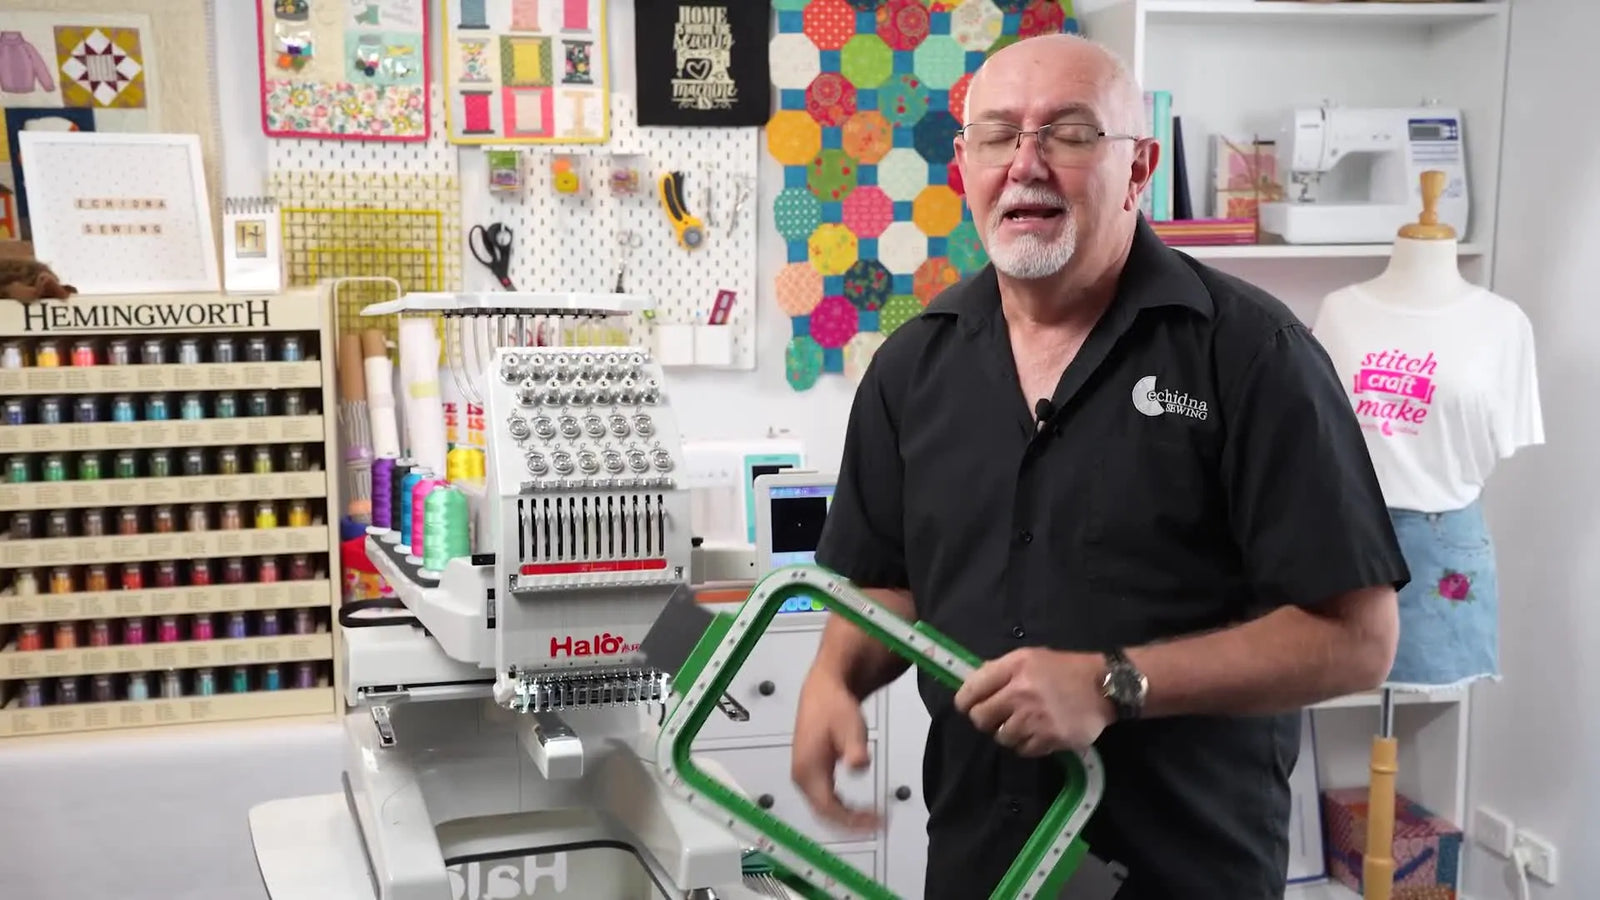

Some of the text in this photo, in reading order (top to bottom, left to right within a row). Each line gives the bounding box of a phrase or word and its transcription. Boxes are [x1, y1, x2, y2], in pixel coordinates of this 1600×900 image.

[679, 6, 727, 23] HOME
[77, 199, 166, 209] ECHIDNA
[84, 224, 162, 235] SEWING
[24, 300, 270, 331] HEMINGWORTH
[1361, 349, 1437, 375] stitch
[1367, 373, 1418, 394] craft
[1147, 388, 1208, 411] echidna
[1165, 403, 1208, 420] SEWING
[1356, 398, 1427, 424] make
[550, 633, 623, 658] Halo
